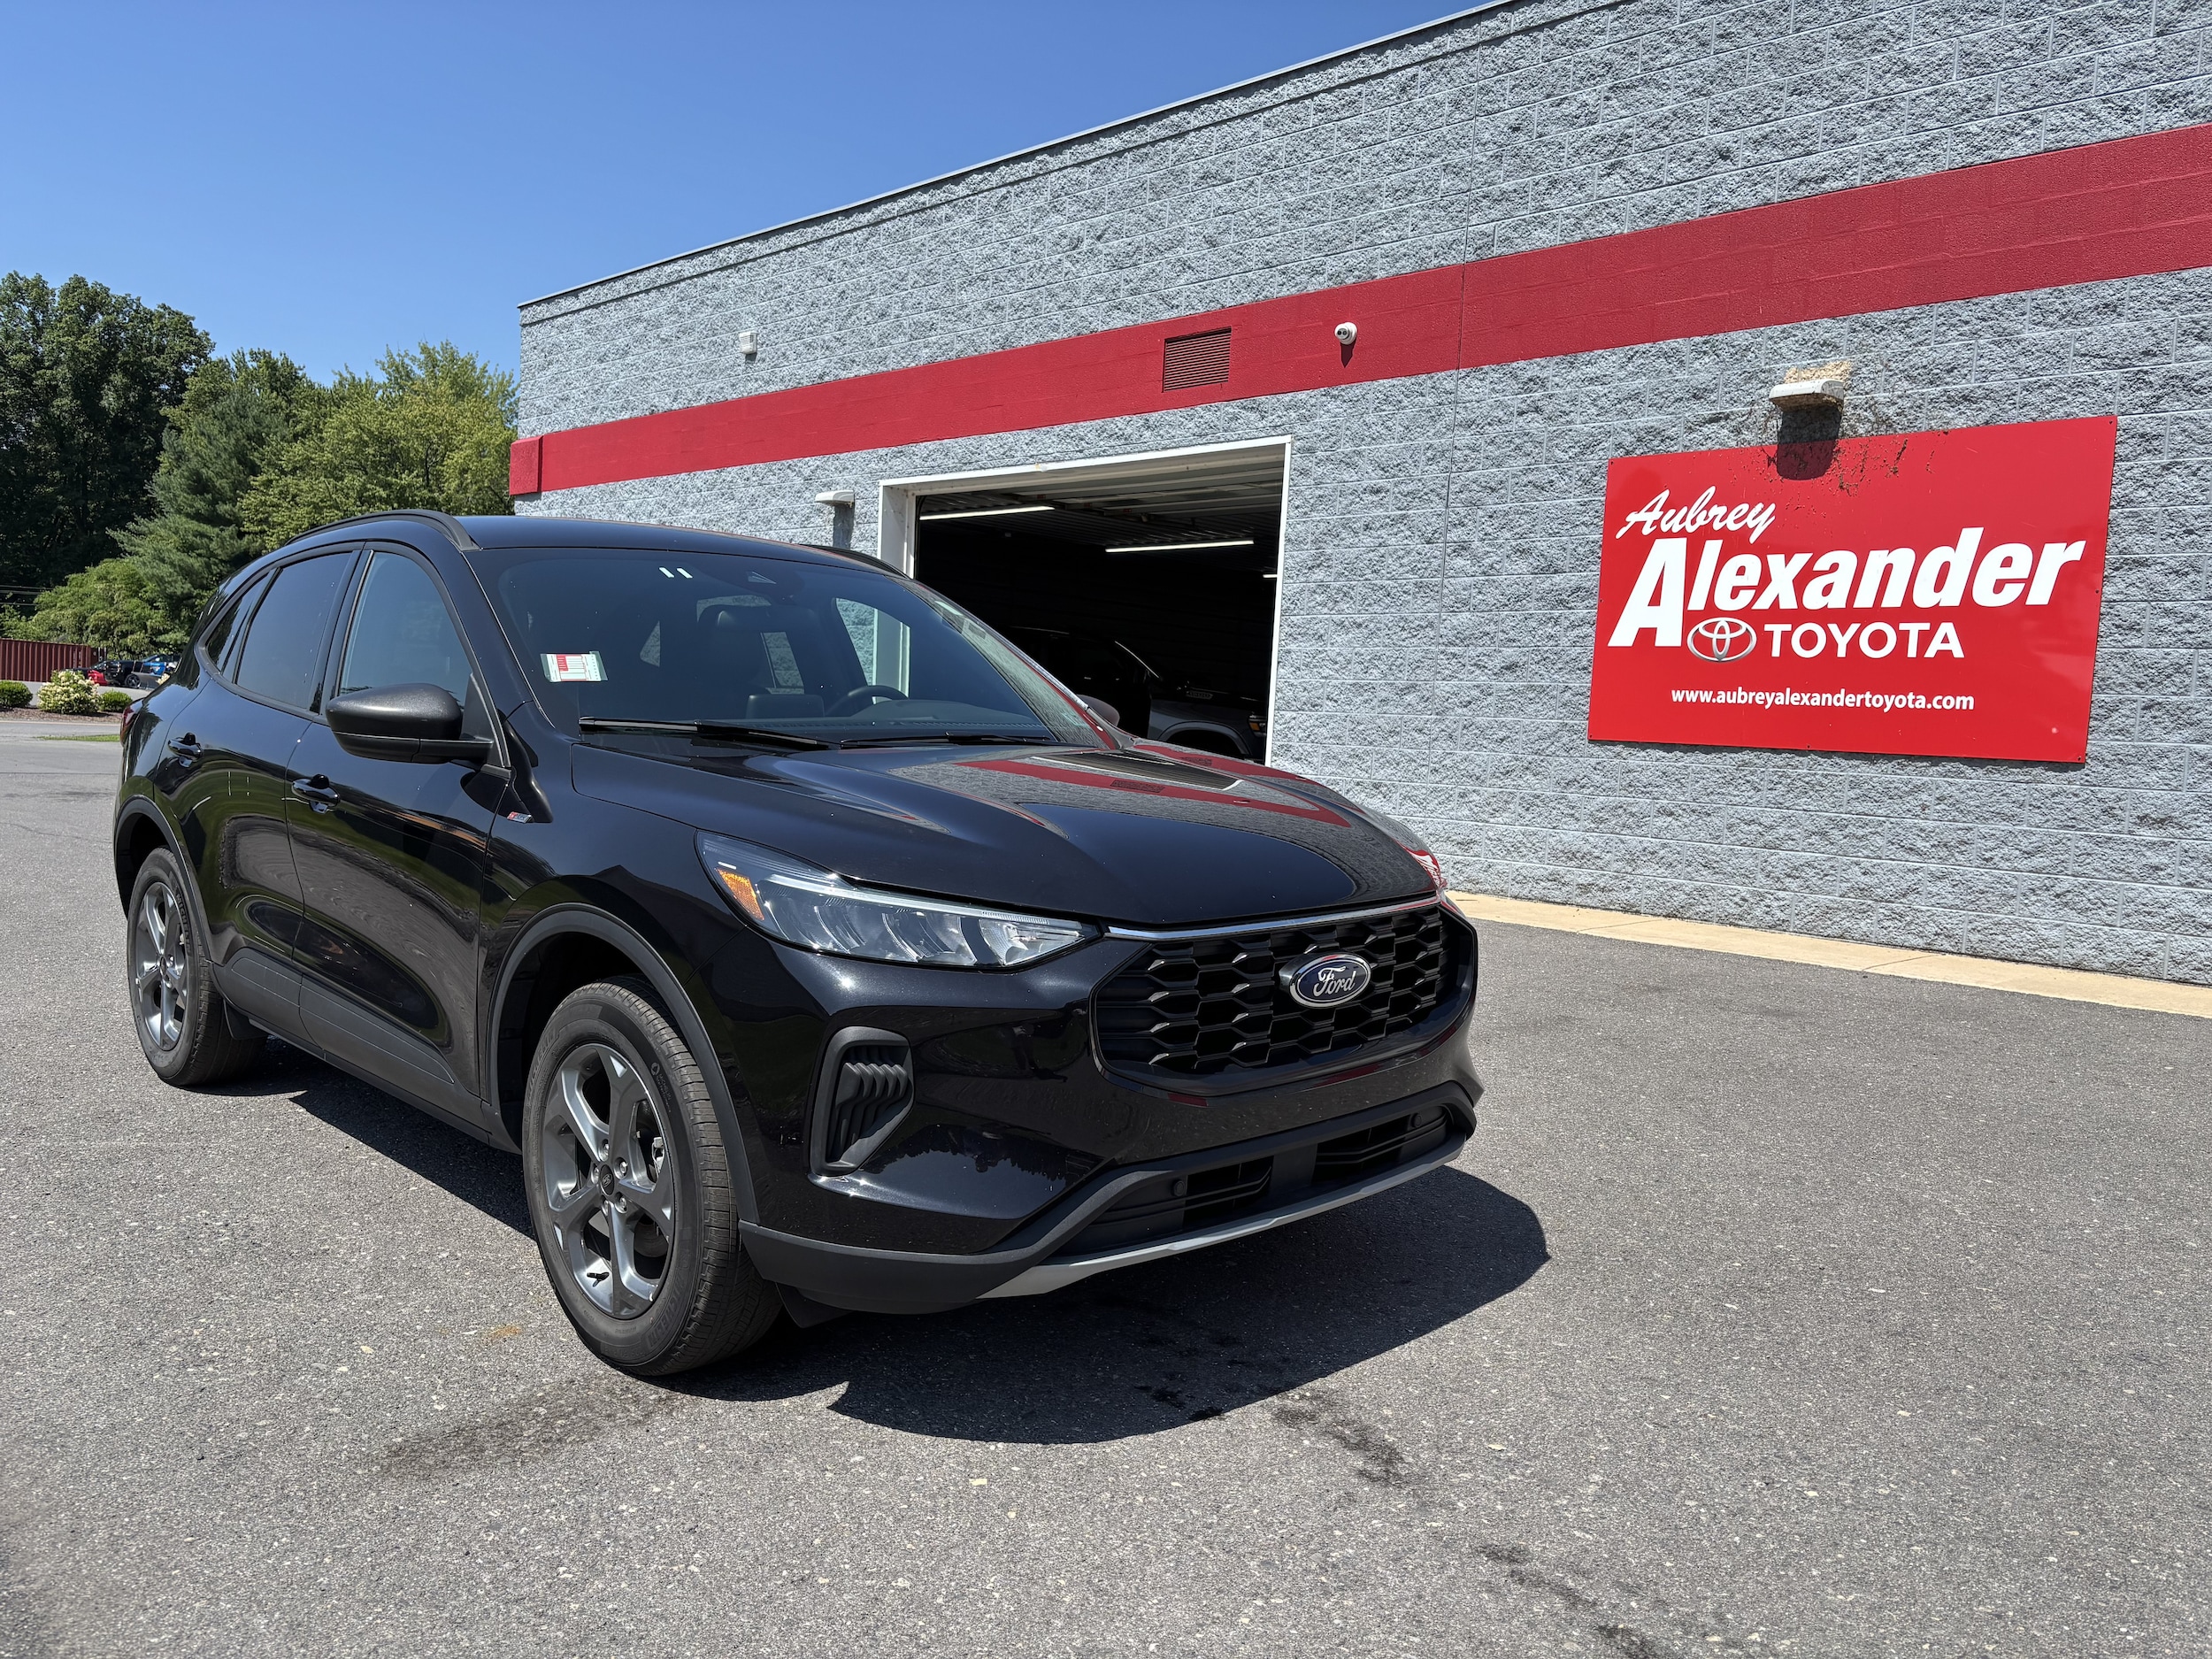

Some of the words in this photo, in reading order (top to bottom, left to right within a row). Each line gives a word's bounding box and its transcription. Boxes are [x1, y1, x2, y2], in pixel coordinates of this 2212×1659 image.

[1616, 486, 1776, 542] Aubrey
[1608, 527, 2086, 648] Alexander
[1765, 622, 1965, 659] TOYOTA
[1671, 687, 1975, 713] www.aubreyalexandertoyota.com
[1313, 966, 1356, 996] Ford
